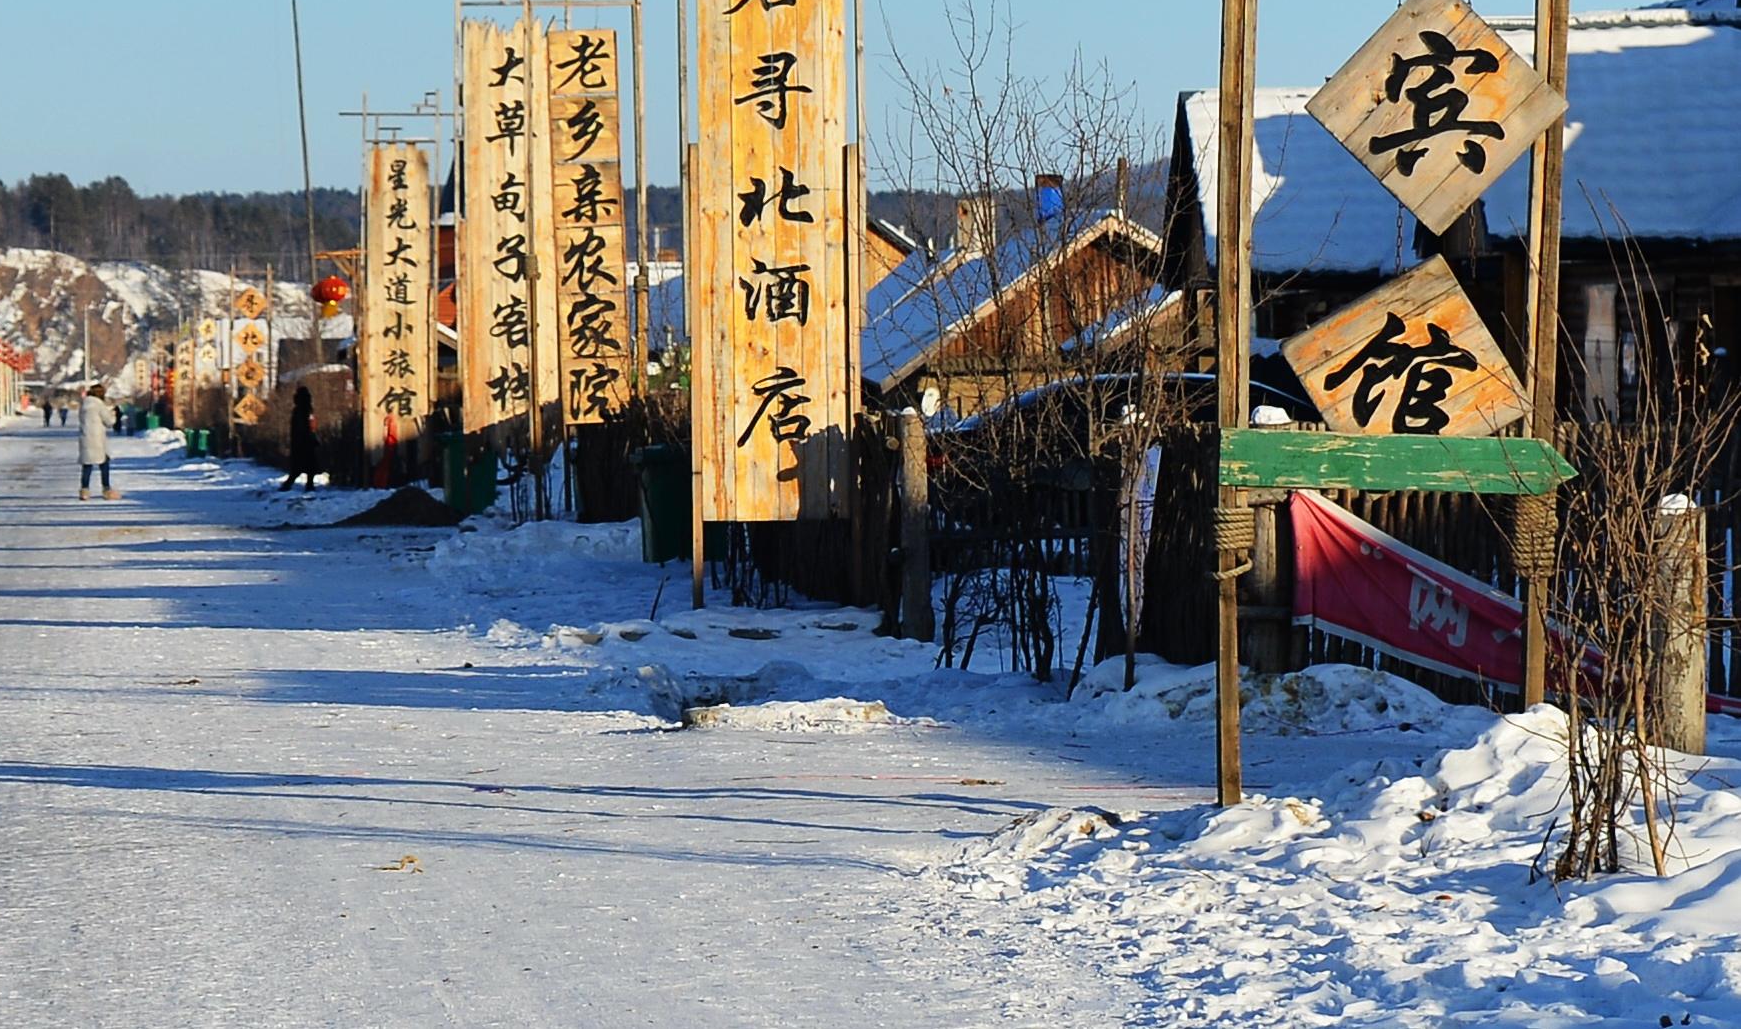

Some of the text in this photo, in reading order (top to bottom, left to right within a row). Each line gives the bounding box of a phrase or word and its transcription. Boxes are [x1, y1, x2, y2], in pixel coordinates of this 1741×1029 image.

[377, 159, 418, 418] 星光大道小旅馆
[485, 47, 532, 412] 大草甸子客栈
[555, 35, 621, 421] 老乡亲农家院
